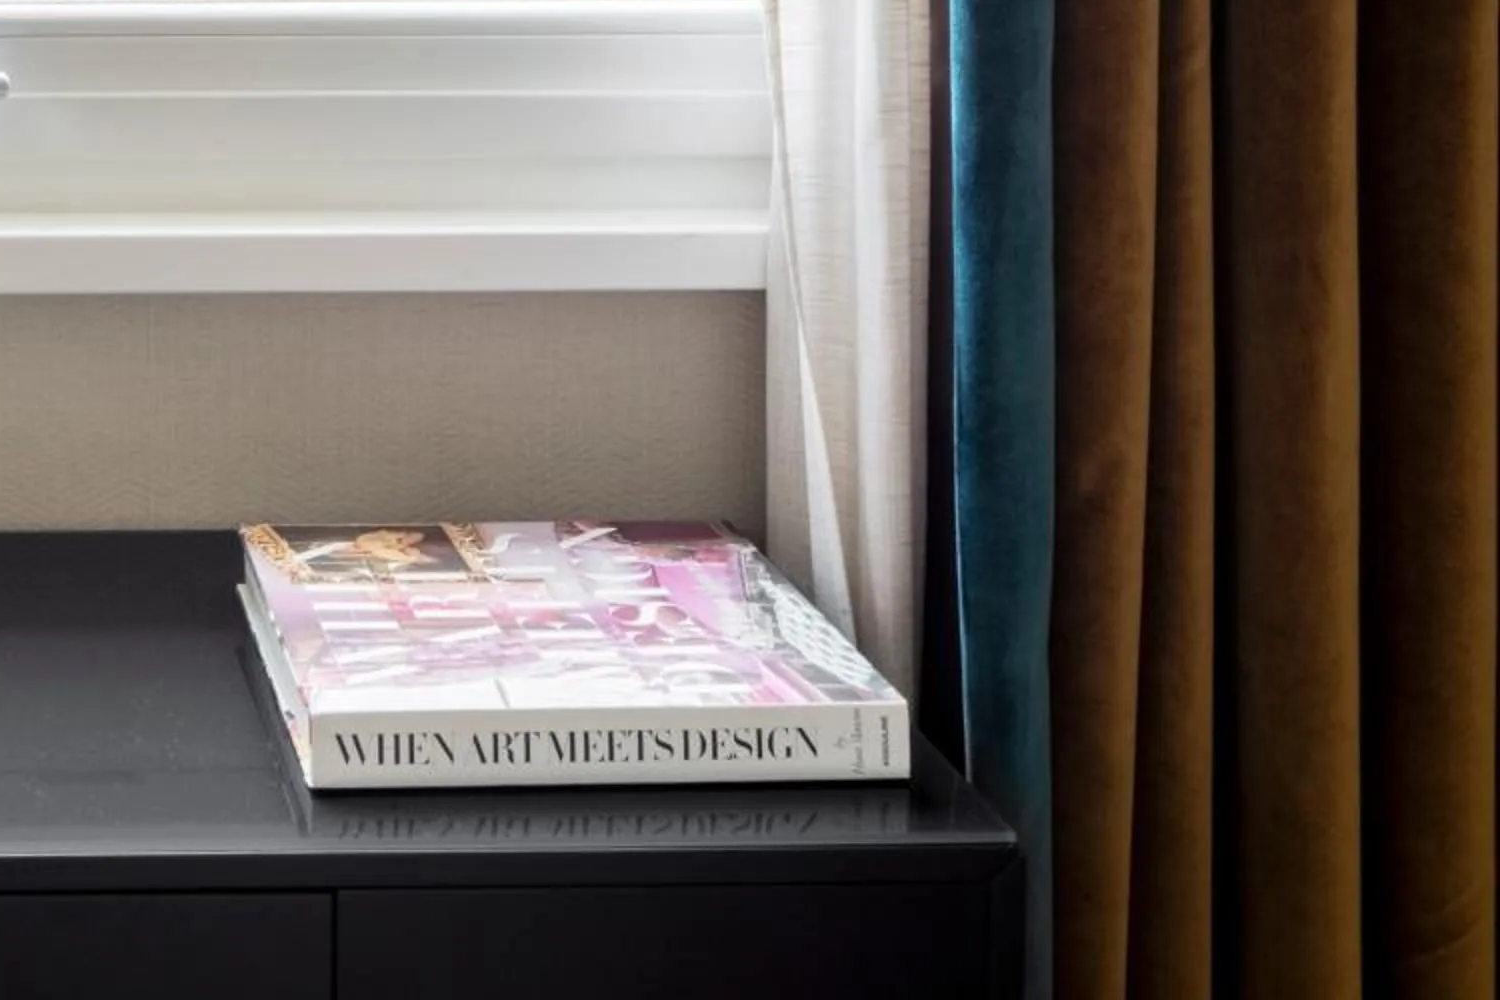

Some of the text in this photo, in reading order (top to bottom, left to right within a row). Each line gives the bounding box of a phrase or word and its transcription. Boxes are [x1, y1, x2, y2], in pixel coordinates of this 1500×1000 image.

[334, 732, 454, 766] WHEN
[469, 730, 541, 764] ART
[548, 728, 674, 763] MEETS
[680, 726, 819, 762] DESIGN
